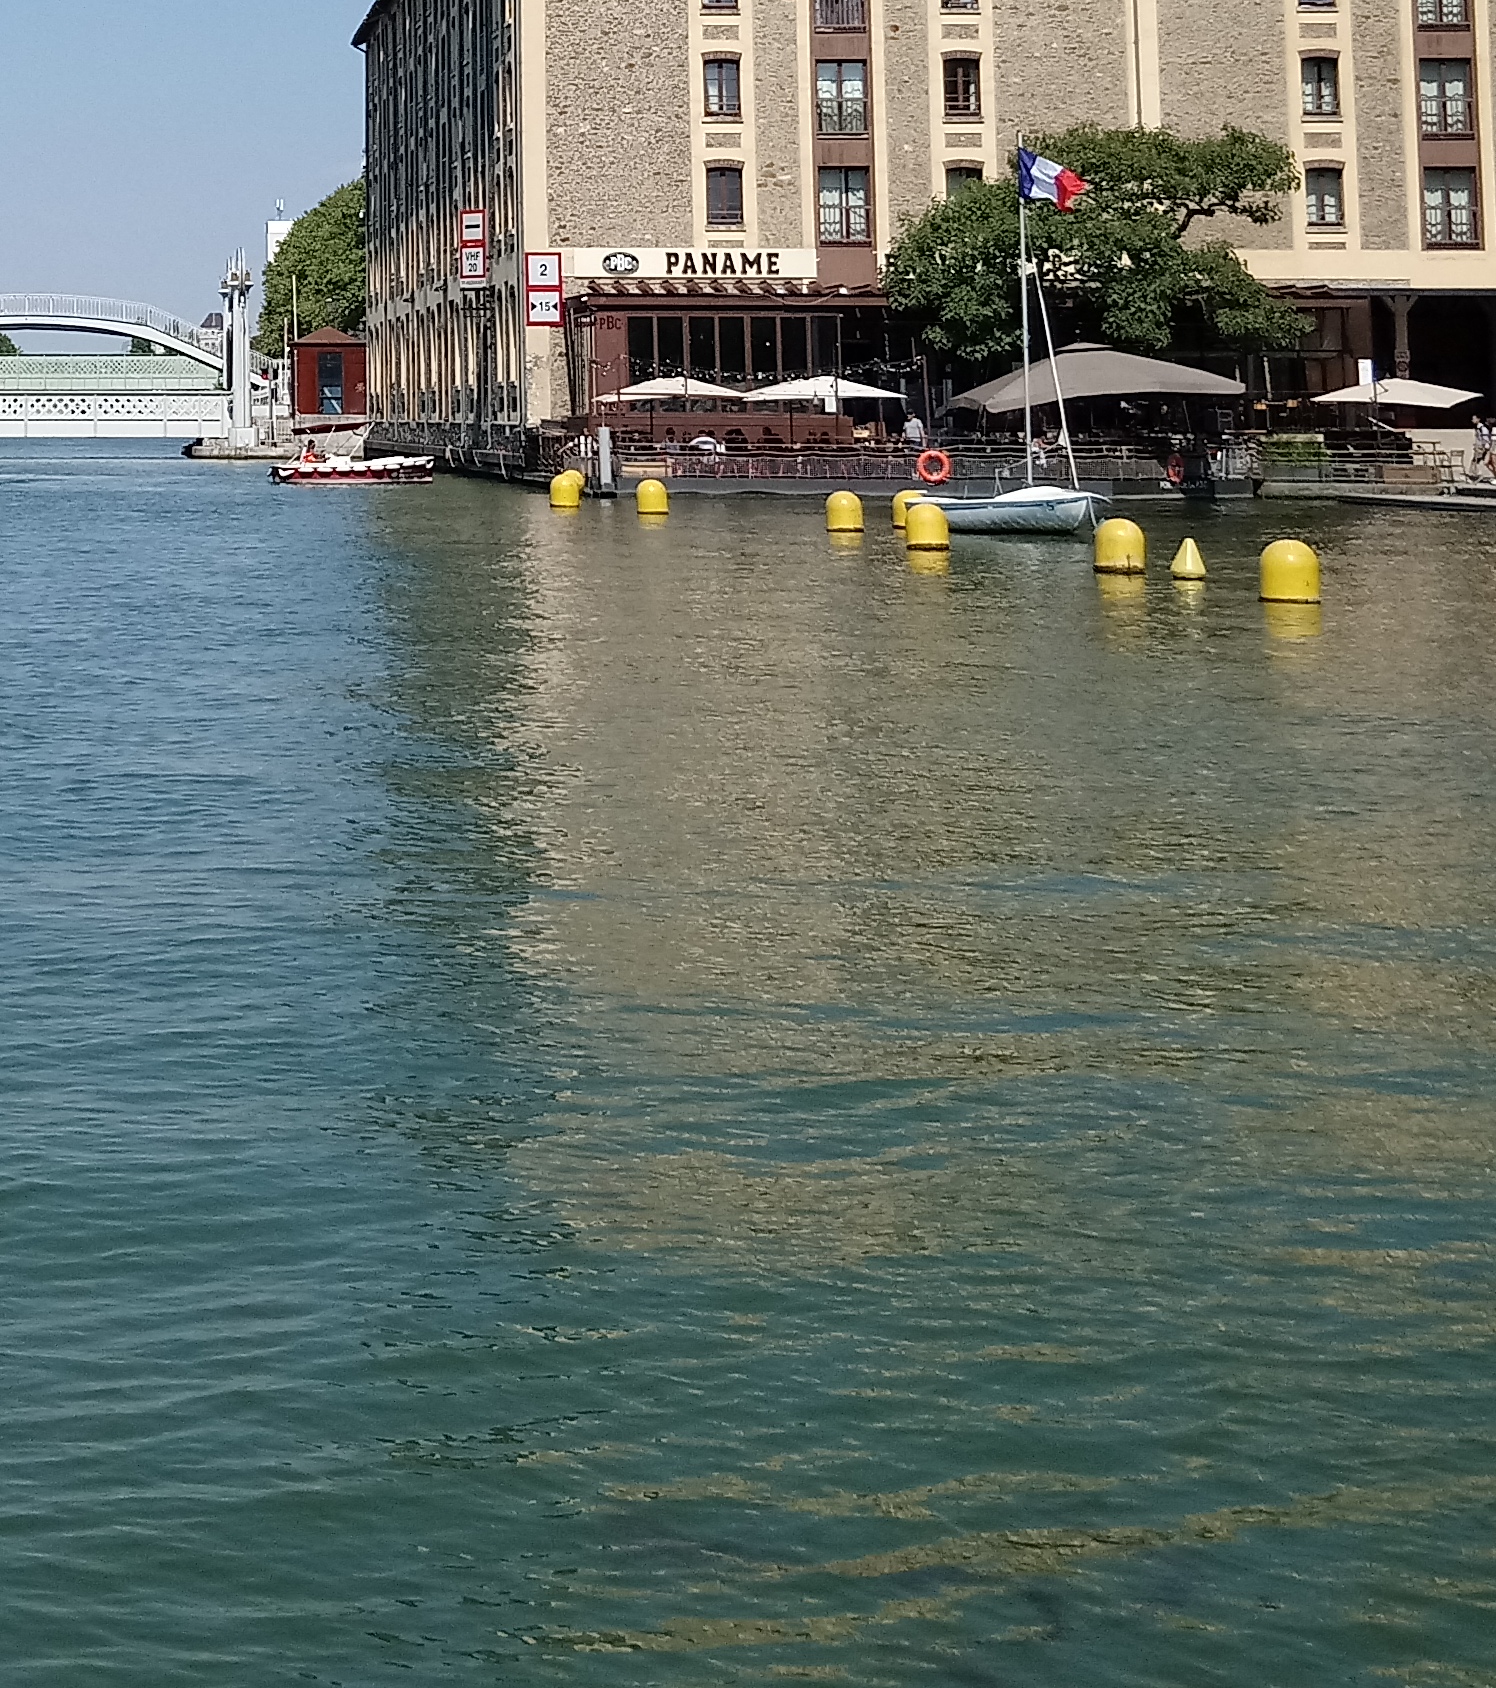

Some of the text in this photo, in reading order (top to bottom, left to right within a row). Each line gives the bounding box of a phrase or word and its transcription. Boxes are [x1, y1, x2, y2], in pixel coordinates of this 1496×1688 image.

[465, 251, 480, 261] VHF
[468, 263, 478, 272] 20
[610, 252, 780, 275] PBC PANAME
[539, 263, 548, 277] 2
[538, 301, 551, 312] 15
[599, 315, 622, 330] PBC
